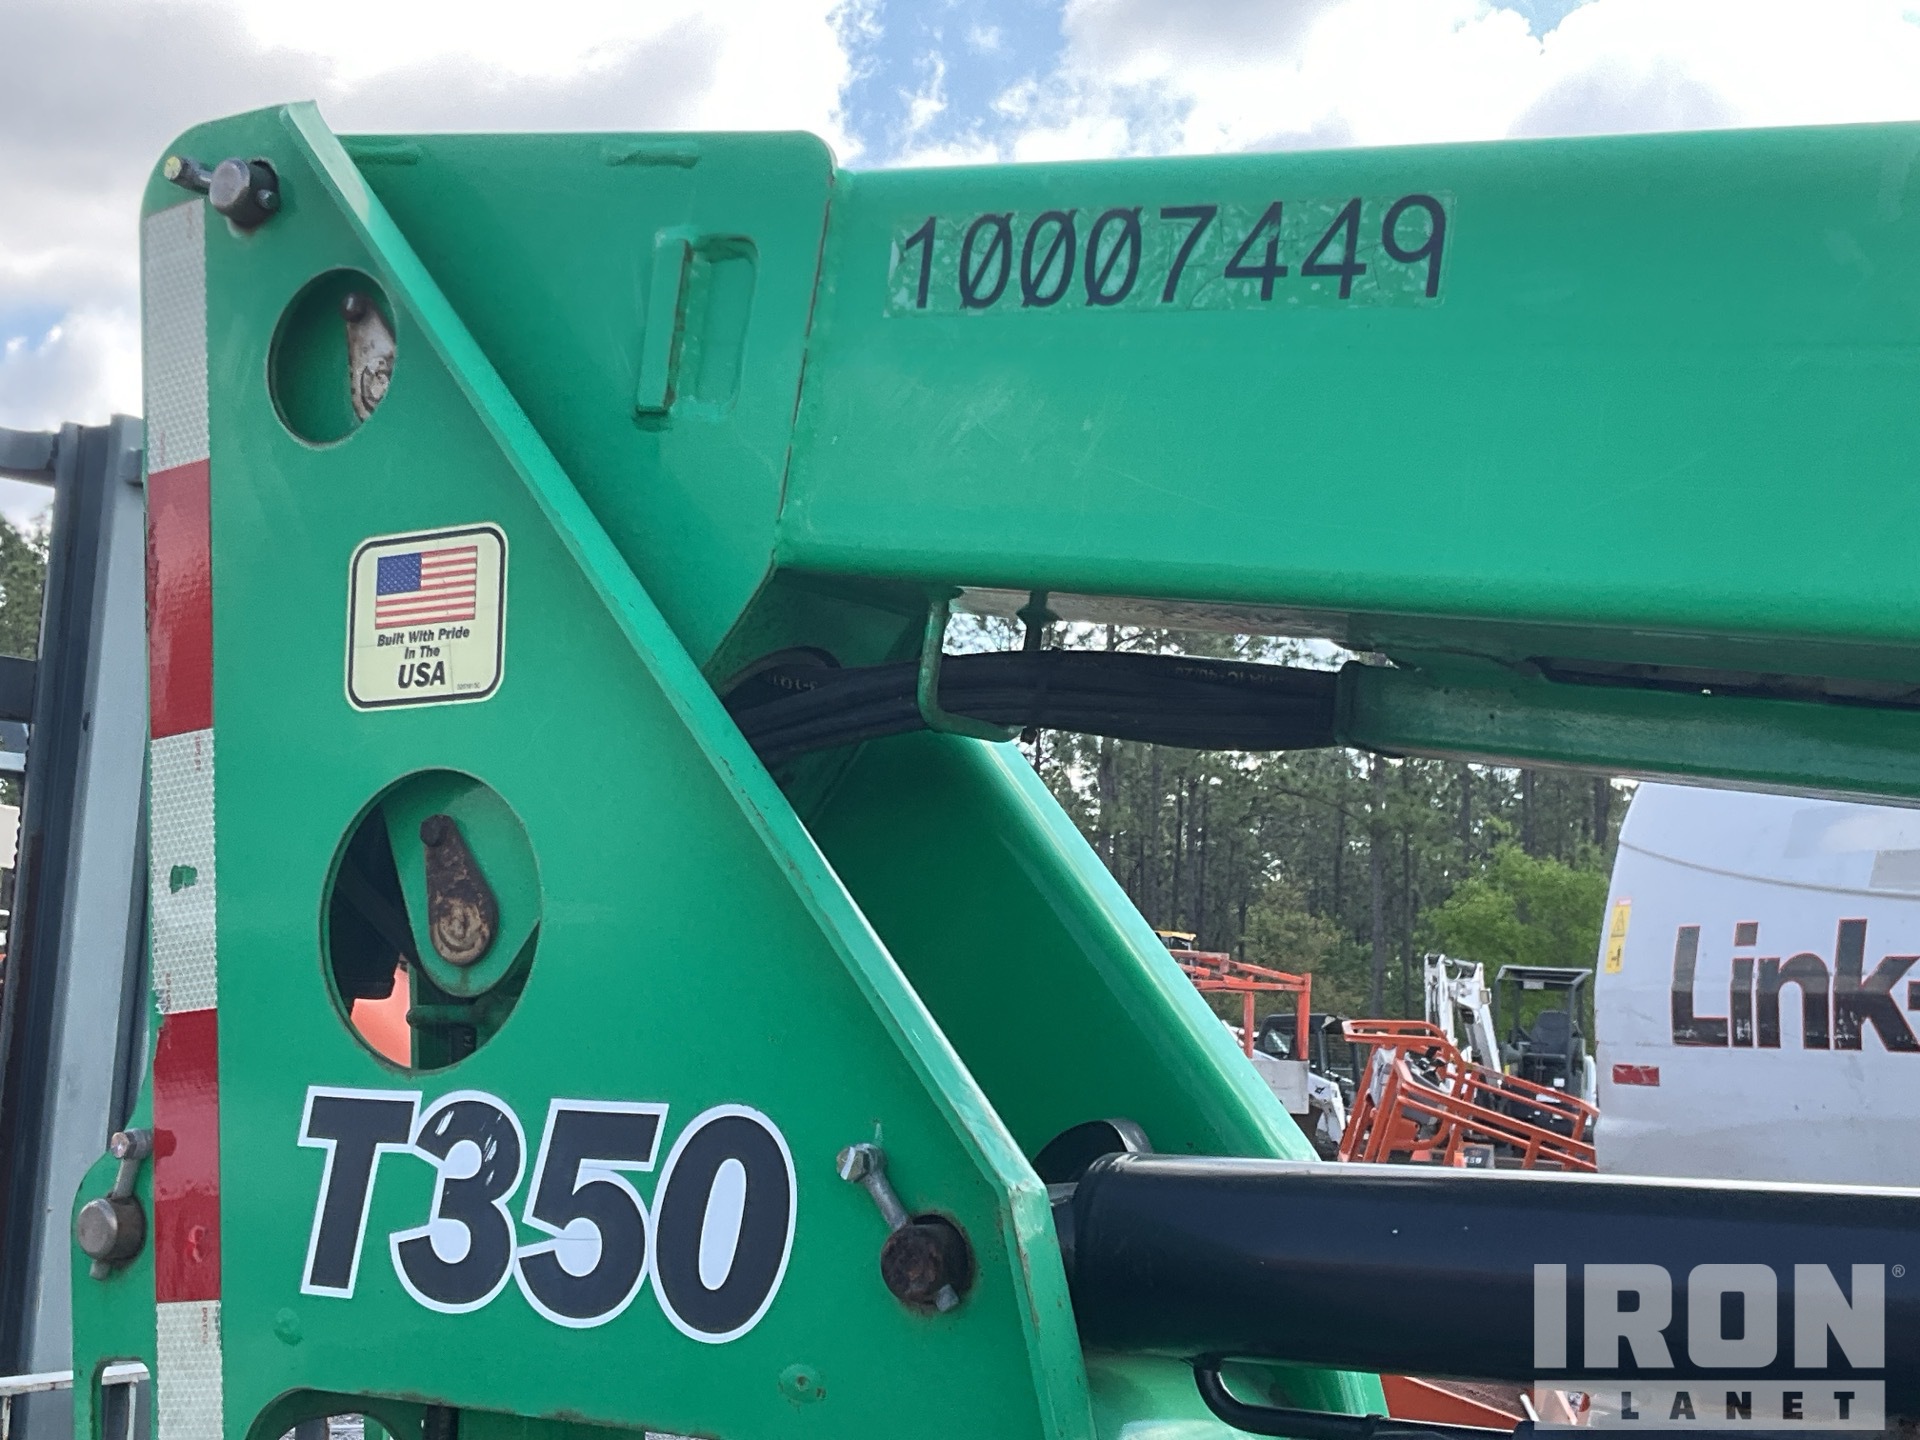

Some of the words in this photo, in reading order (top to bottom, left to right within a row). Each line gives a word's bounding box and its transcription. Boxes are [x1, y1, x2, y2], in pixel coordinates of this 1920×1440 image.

[904, 193, 1450, 310] 10007449
[377, 632, 405, 647] Built
[408, 630, 435, 643] With
[437, 626, 470, 640] Pride
[404, 647, 416, 660] In
[419, 645, 440, 658] The
[397, 660, 446, 690] USA
[298, 1085, 797, 1346] T350
